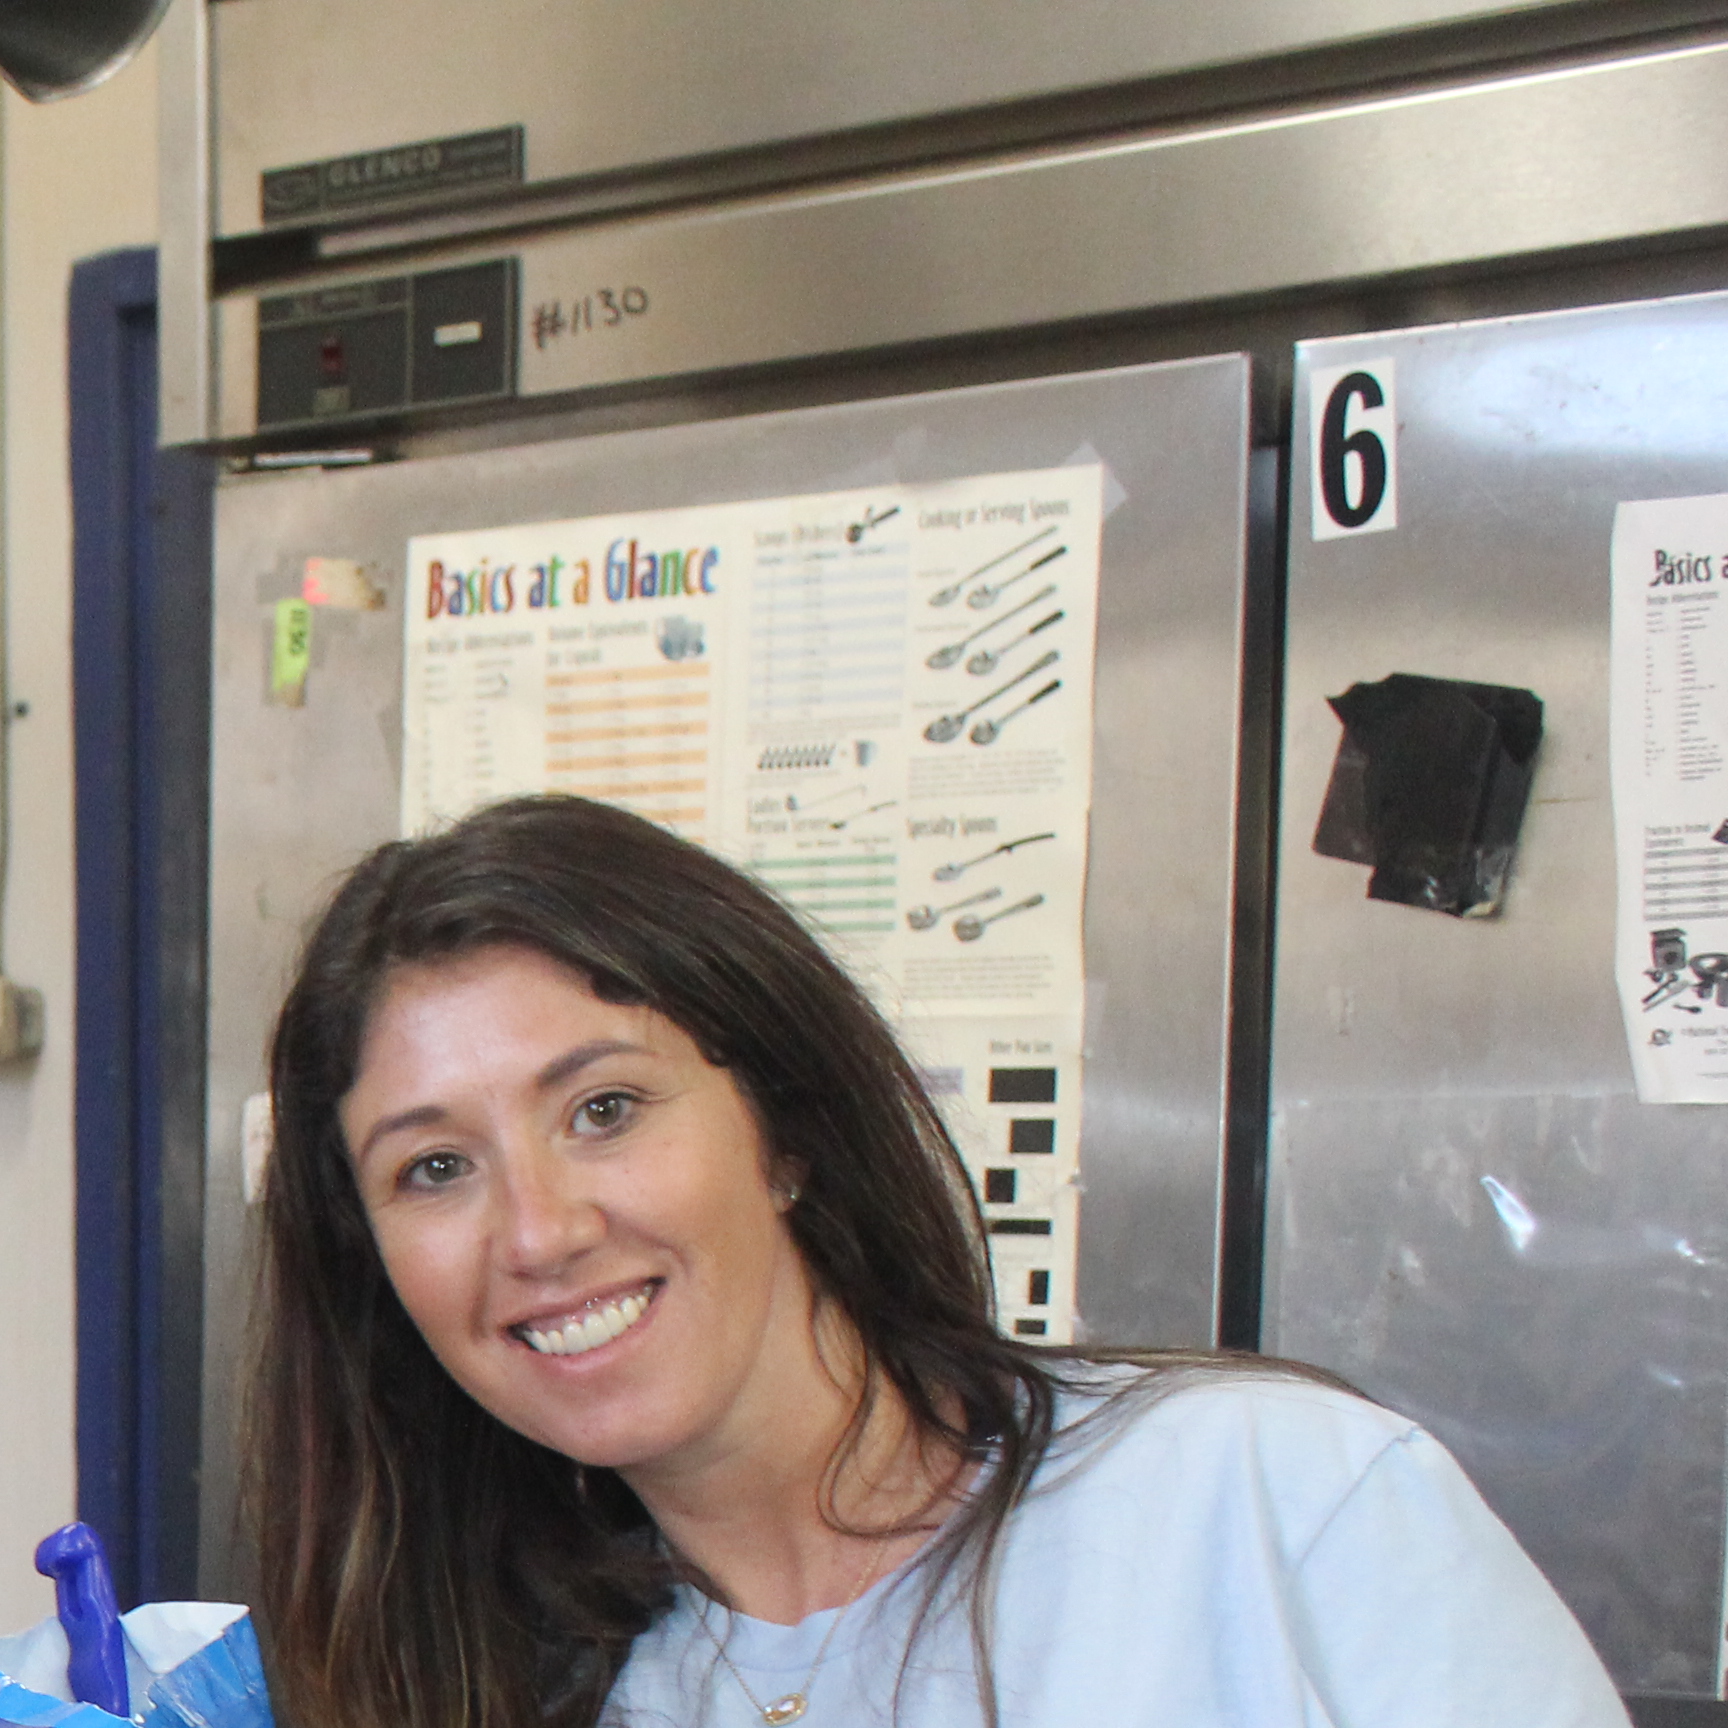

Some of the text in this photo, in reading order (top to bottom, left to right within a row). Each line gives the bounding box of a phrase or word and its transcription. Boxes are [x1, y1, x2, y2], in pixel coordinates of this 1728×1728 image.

[1317, 371, 1388, 530] 6
[426, 537, 720, 620] Basics at a Glance
[1649, 549, 1712, 587] Basics
